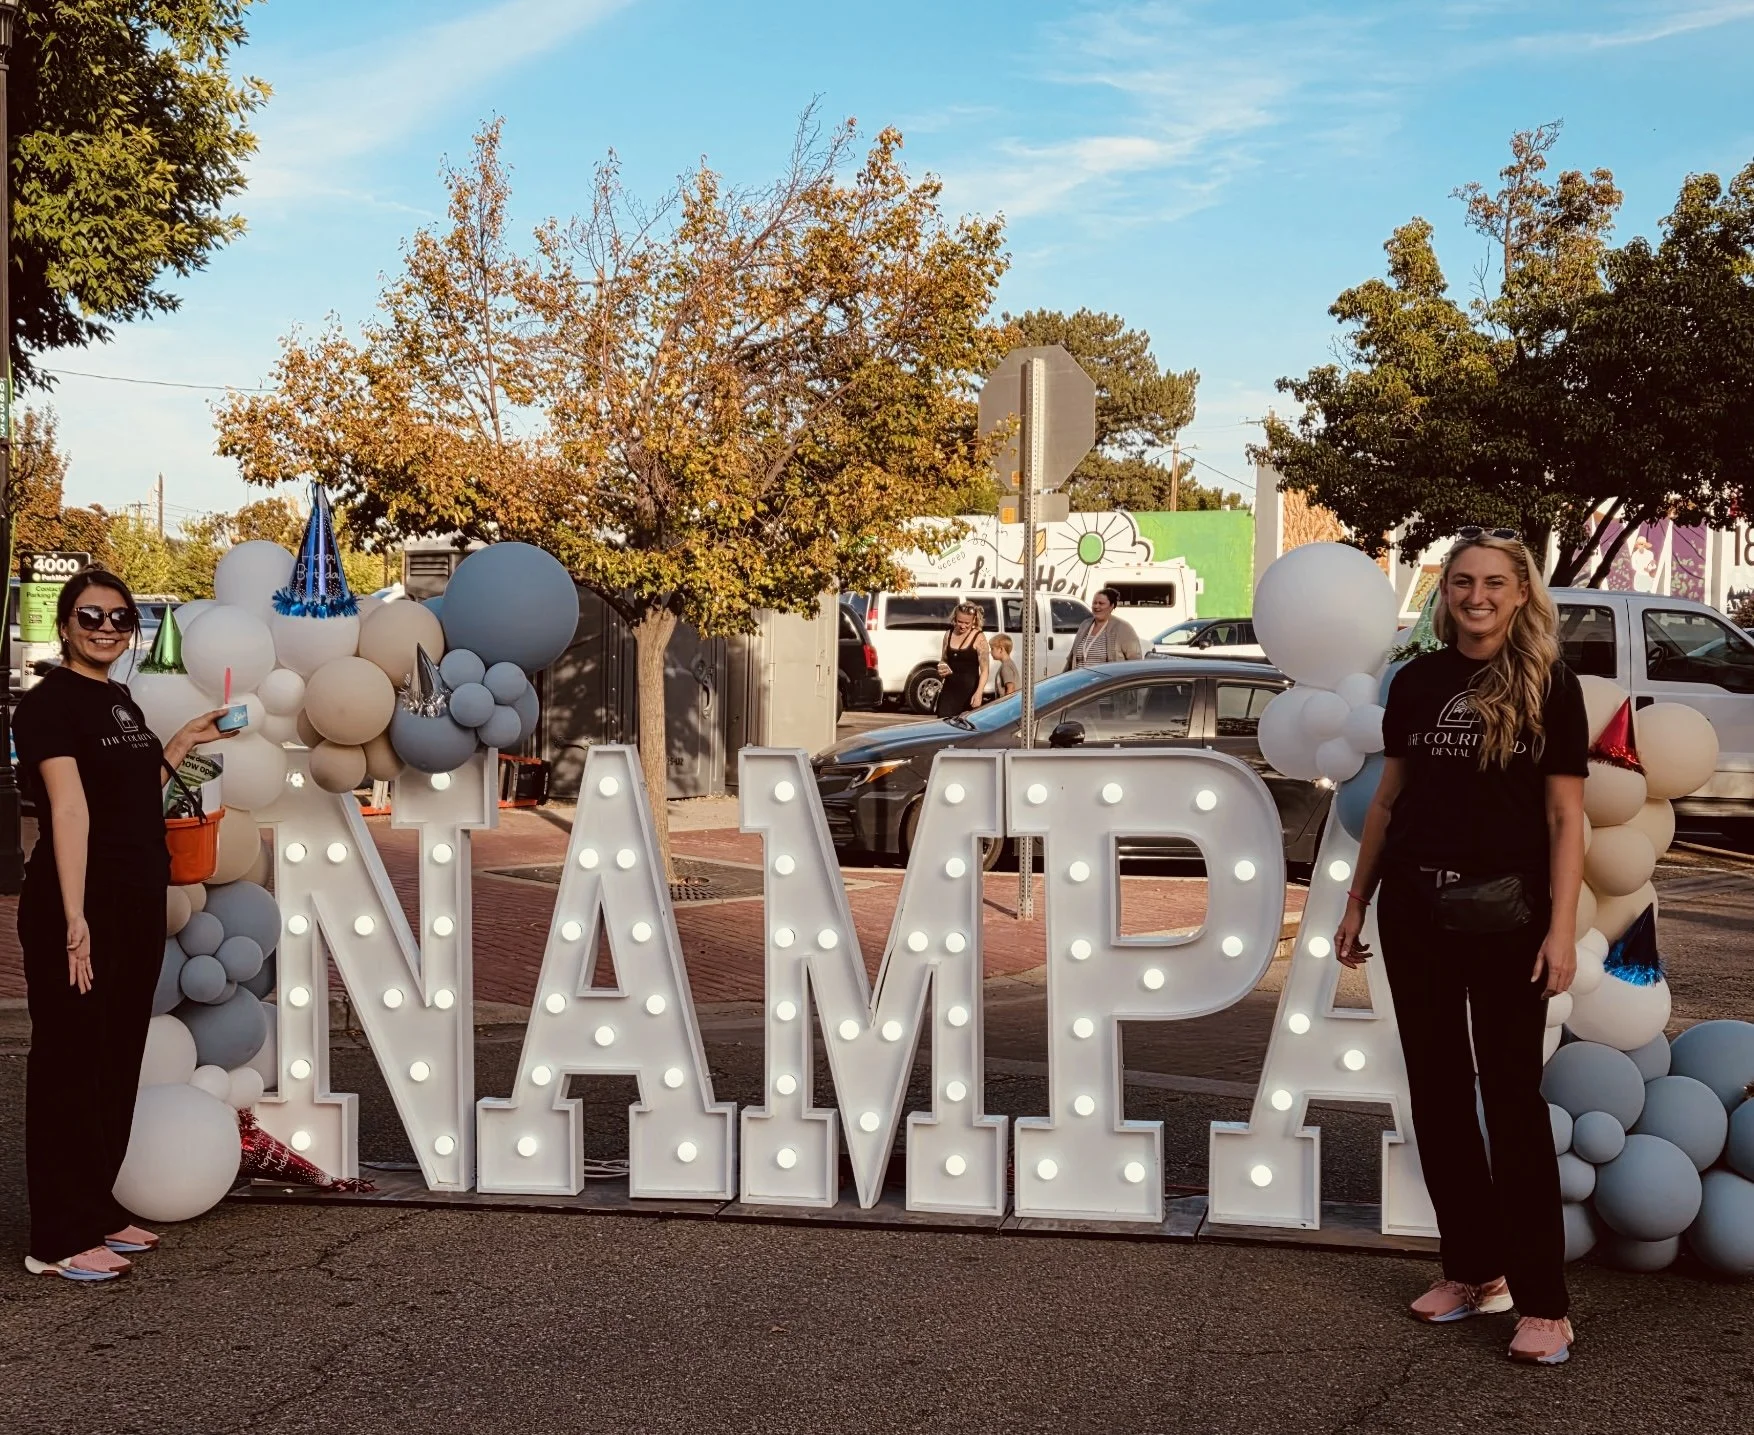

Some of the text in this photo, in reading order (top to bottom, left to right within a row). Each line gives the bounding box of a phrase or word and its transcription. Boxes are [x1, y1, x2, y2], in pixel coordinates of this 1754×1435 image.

[33, 558, 79, 573] 4000
[1431, 747, 1470, 757] DENTAL
[252, 743, 1442, 1238] NAMPA
